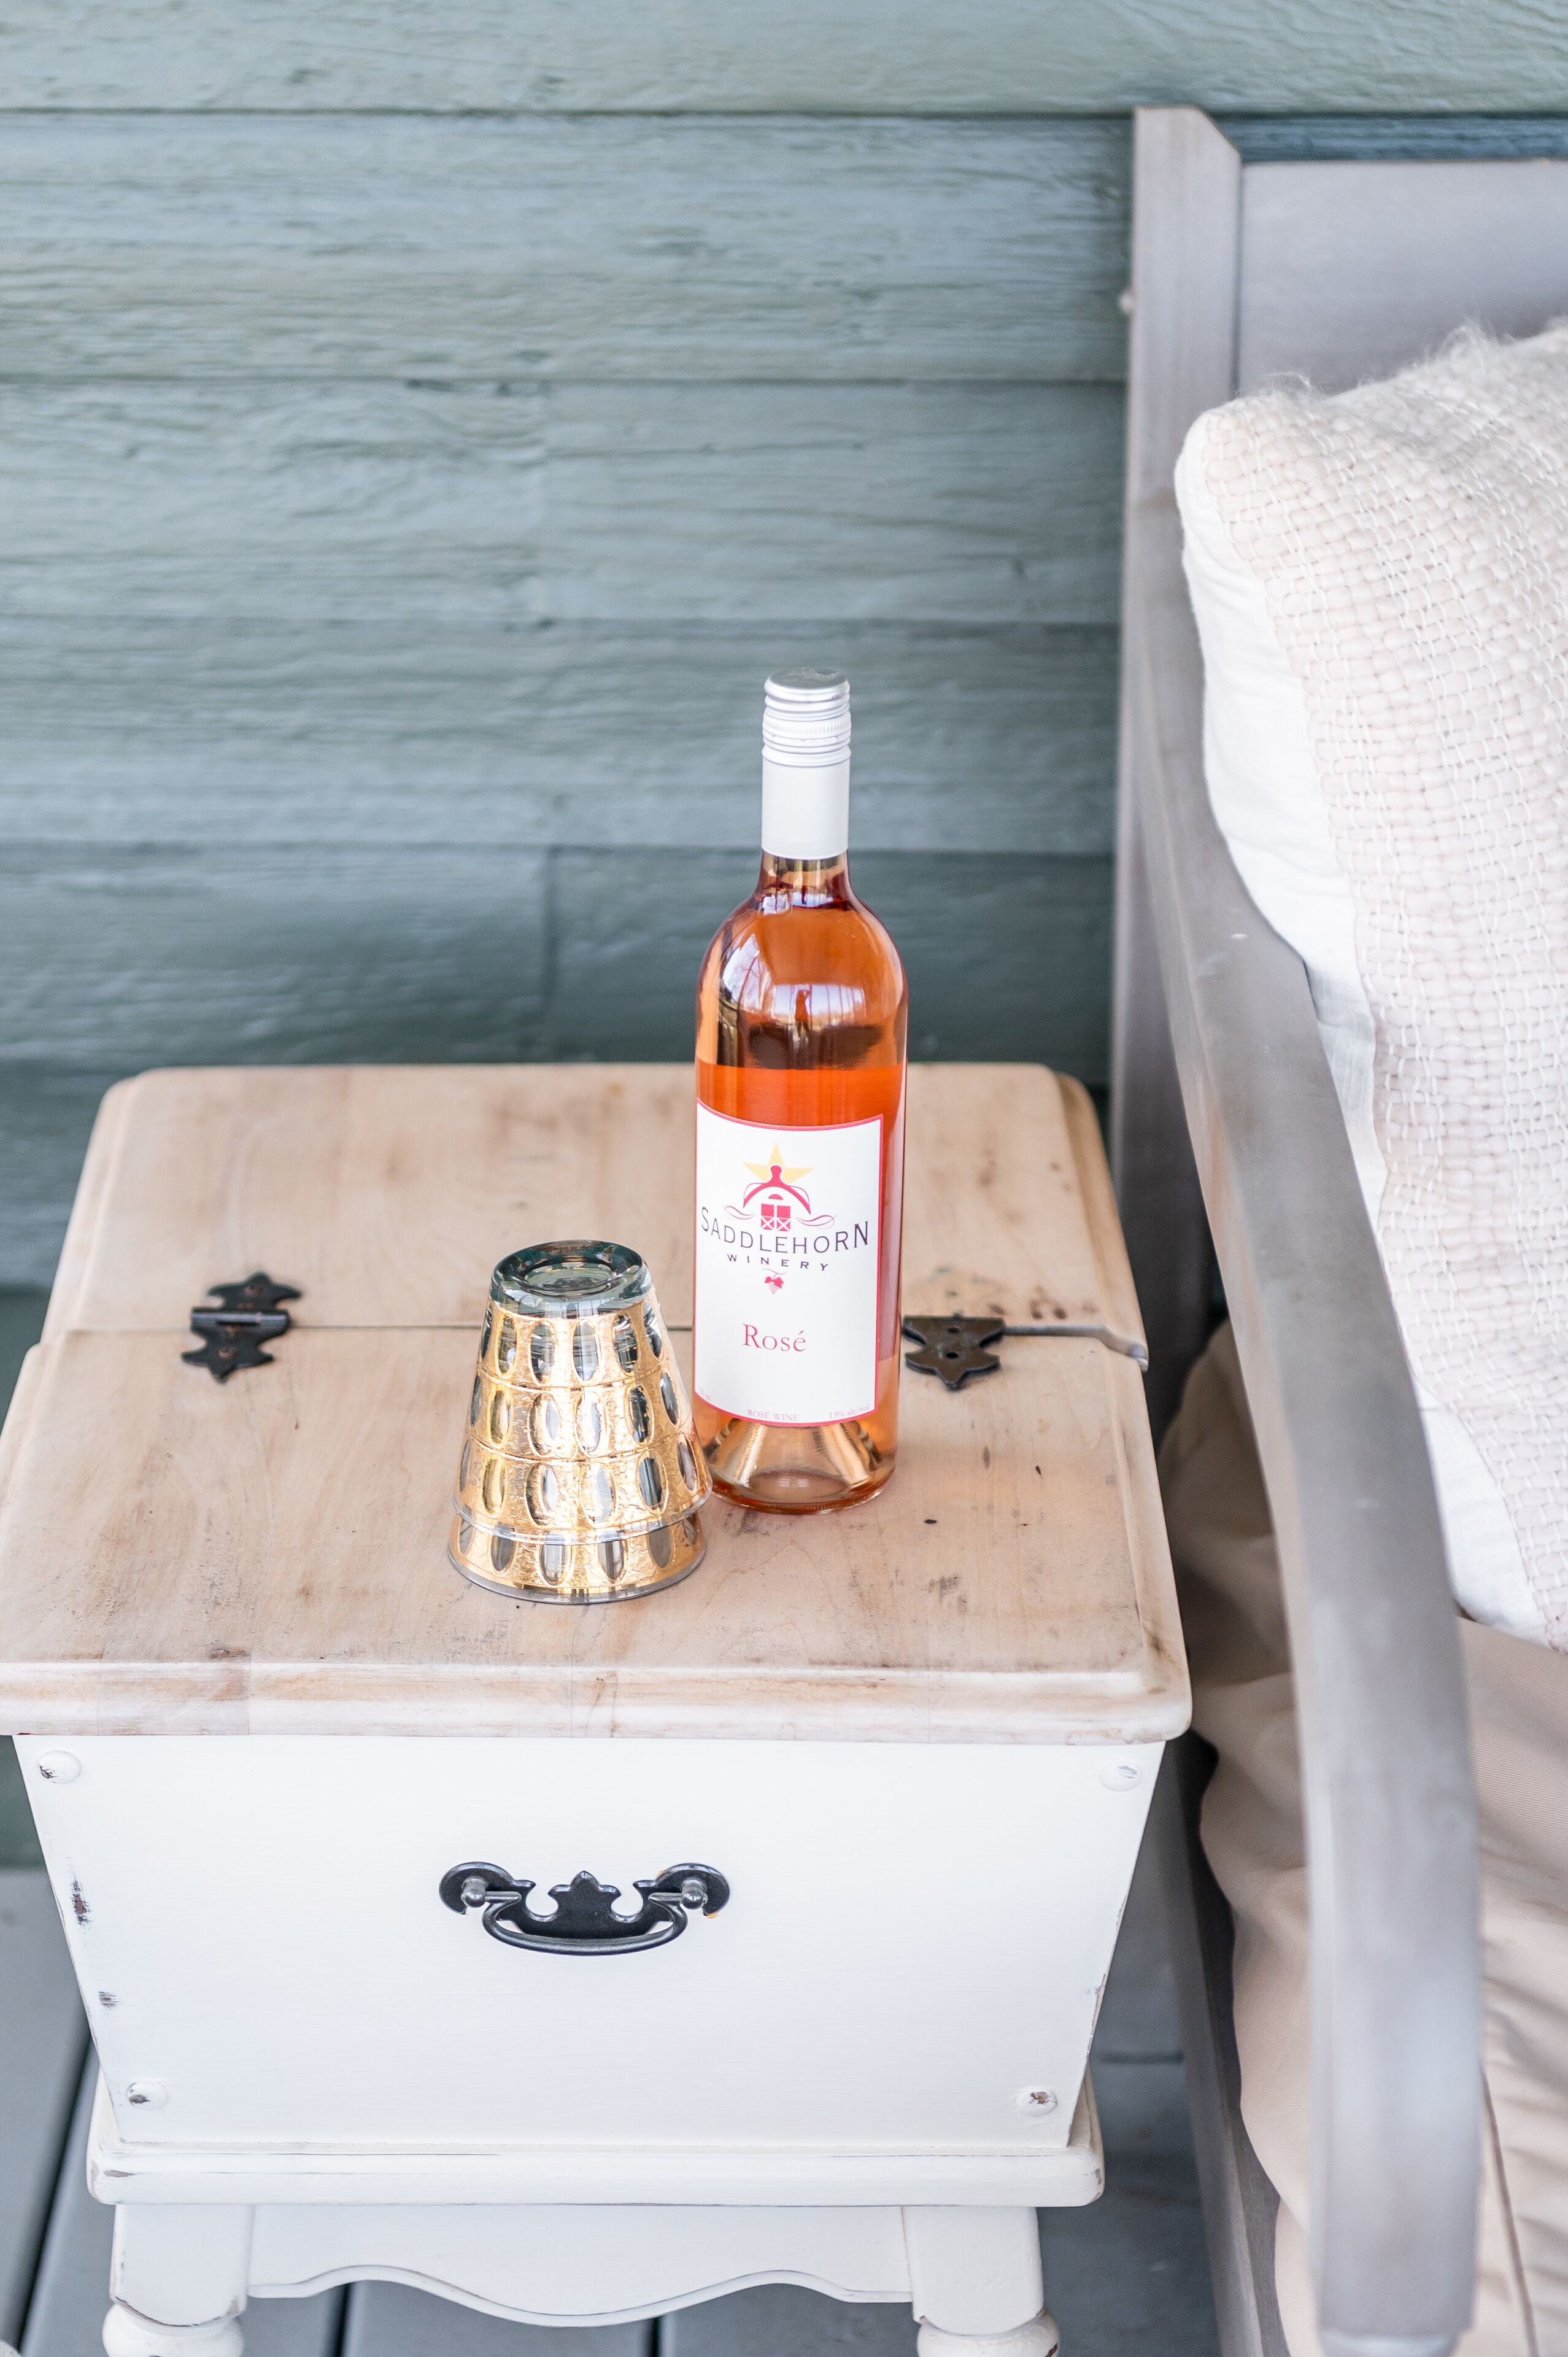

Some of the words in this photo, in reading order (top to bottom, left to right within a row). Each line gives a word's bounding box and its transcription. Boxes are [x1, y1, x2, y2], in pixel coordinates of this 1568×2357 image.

[701, 1207, 869, 1253] SADDLEHORN
[727, 1254, 828, 1271] WINERY
[742, 1323, 806, 1352] Rosé
[747, 1409, 771, 1420] ROSÉ
[847, 1403, 870, 1416] alc/vol
